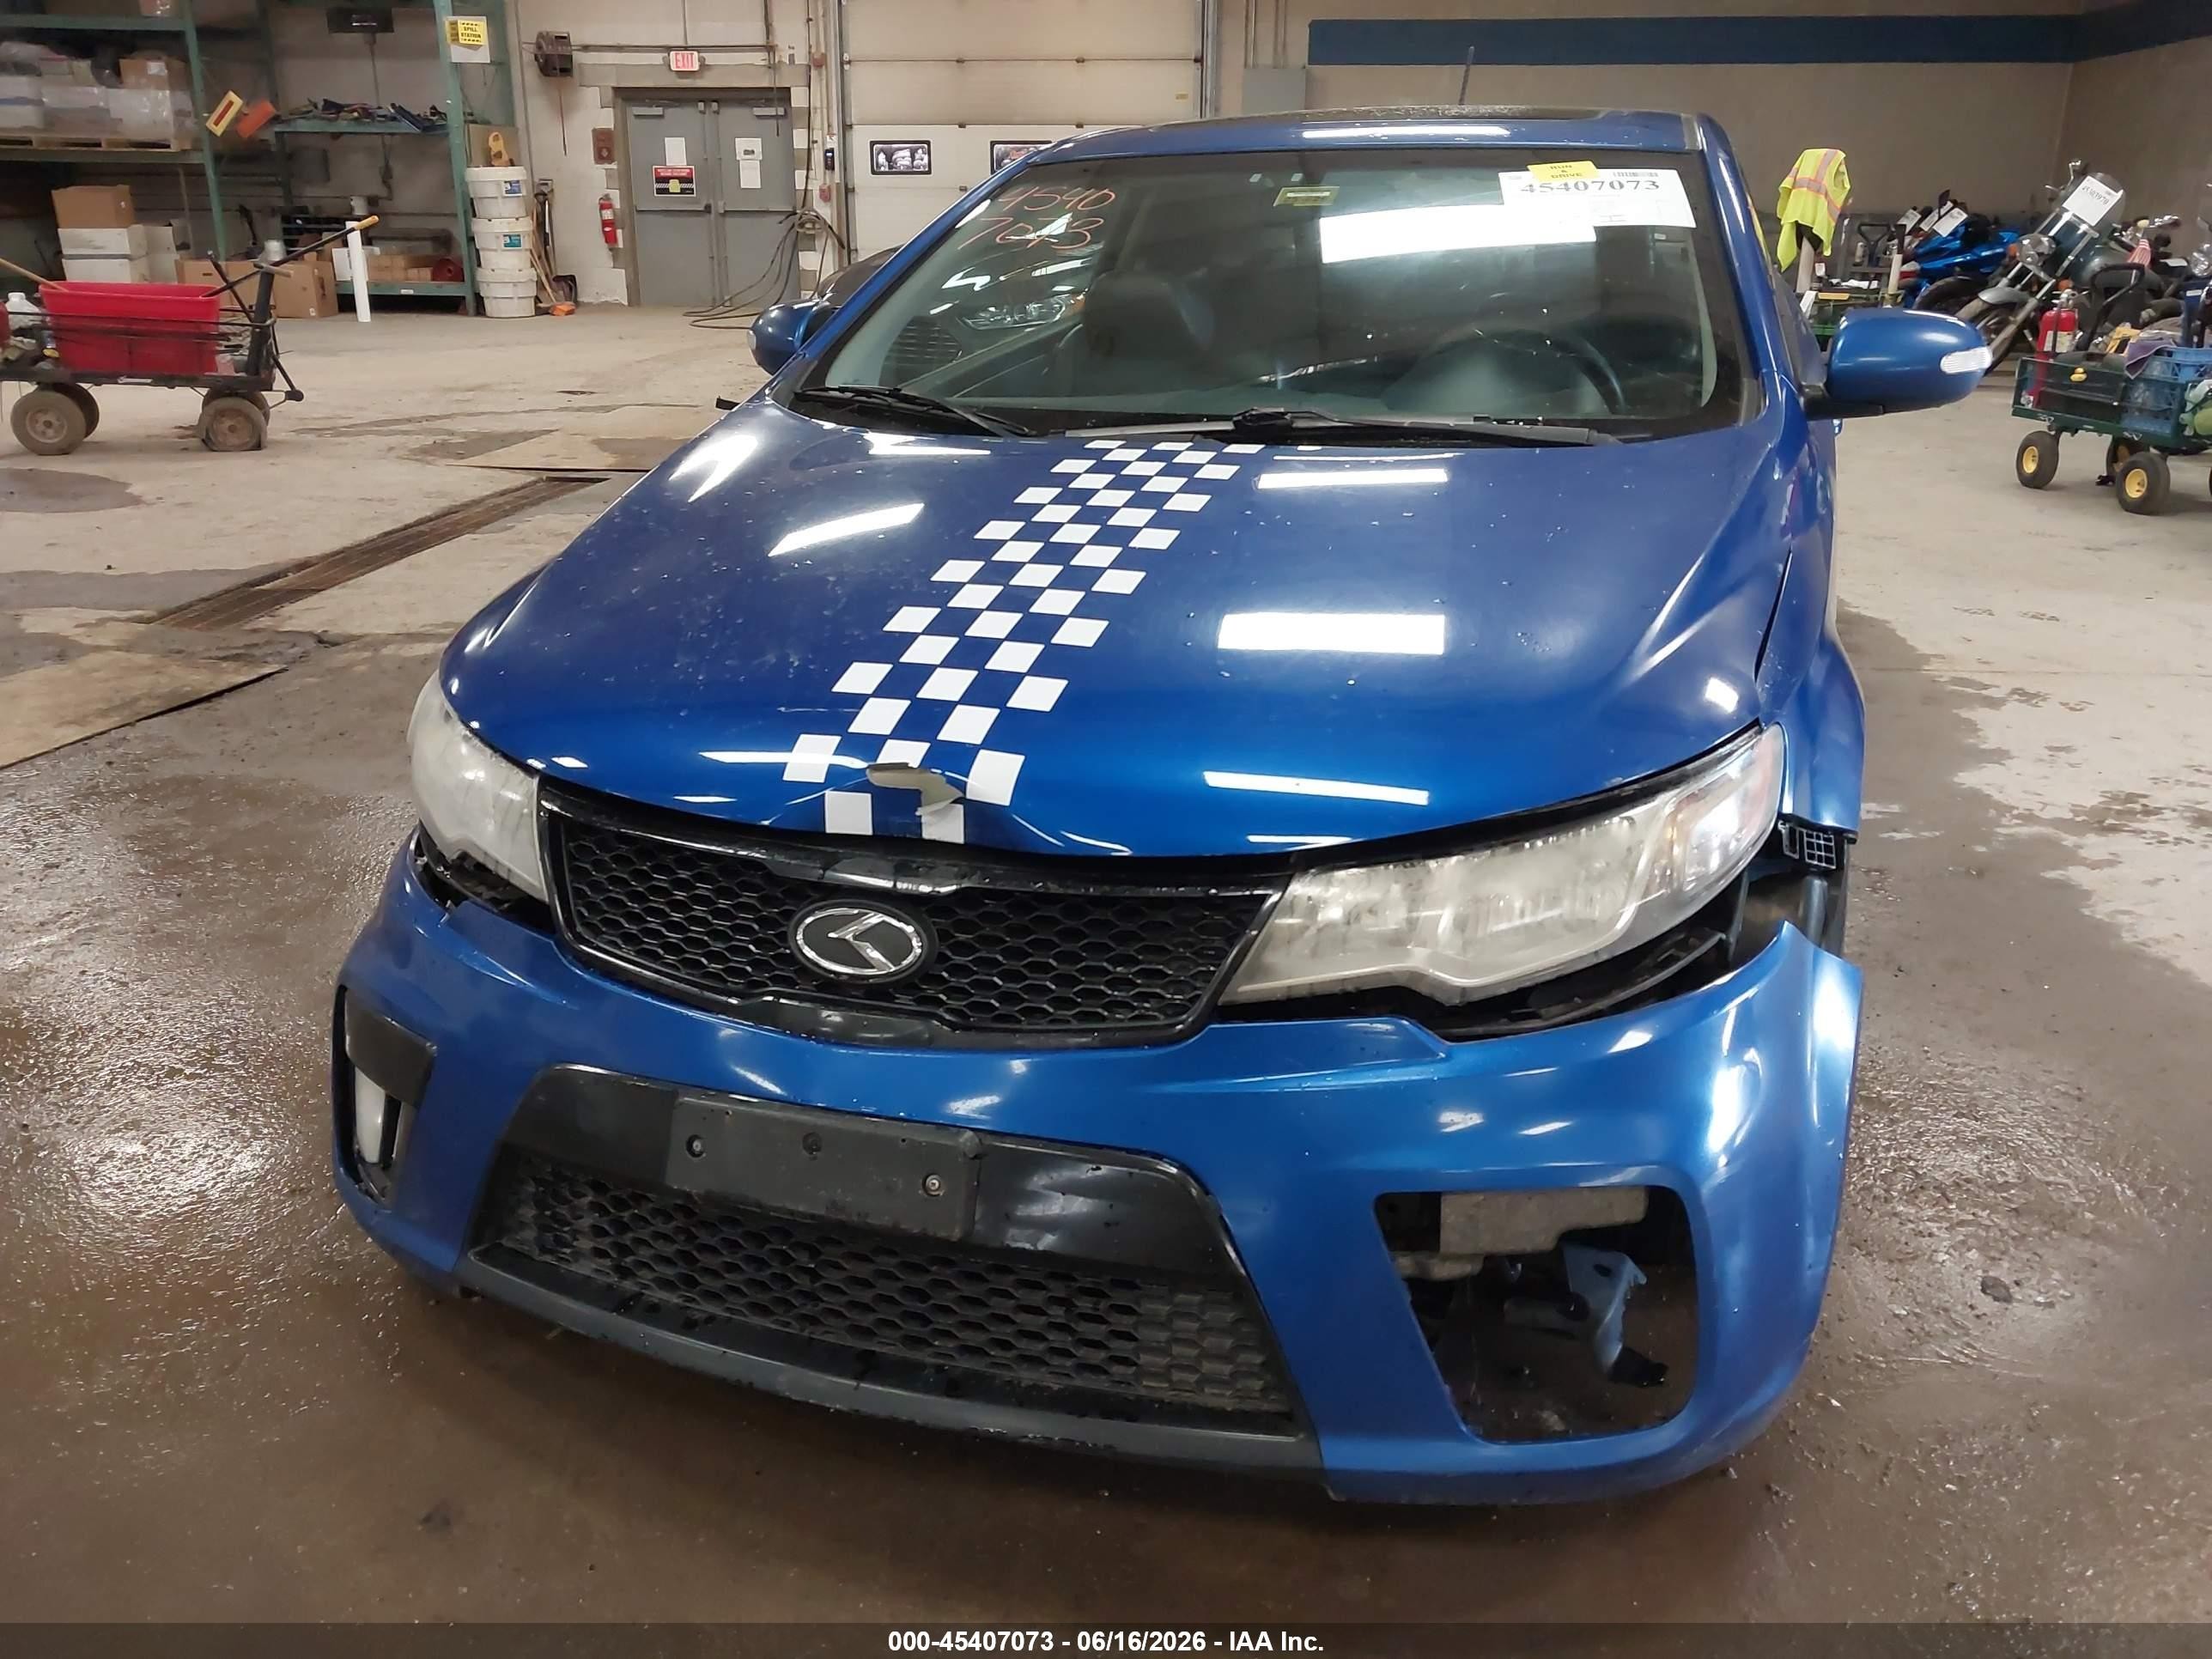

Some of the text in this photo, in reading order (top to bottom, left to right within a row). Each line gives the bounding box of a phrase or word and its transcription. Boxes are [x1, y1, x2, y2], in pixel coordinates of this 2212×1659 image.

[674, 52, 695, 70] EXIT
[1521, 179, 1661, 193] 45407073
[998, 185, 1116, 212] 4540
